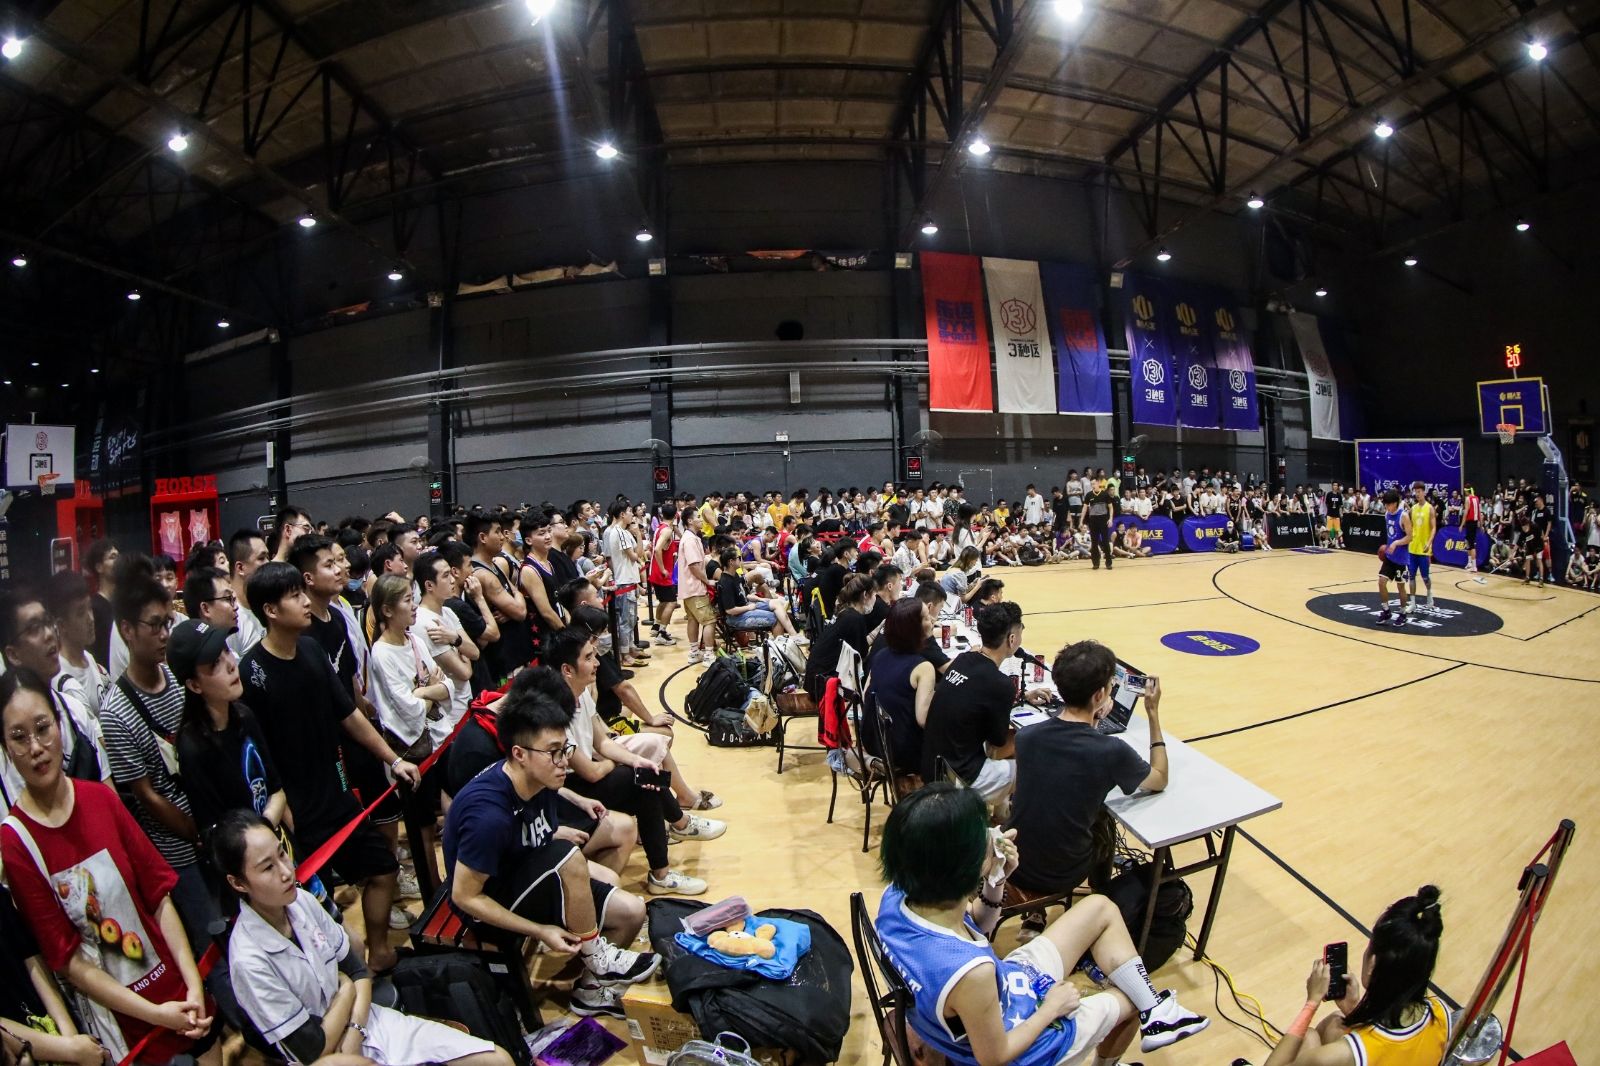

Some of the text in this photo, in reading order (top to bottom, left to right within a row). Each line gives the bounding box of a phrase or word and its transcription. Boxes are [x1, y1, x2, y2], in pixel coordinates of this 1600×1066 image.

[155, 475, 217, 496] HORSE
[945, 669, 969, 686] STAFF
[133, 978, 150, 992] AND
